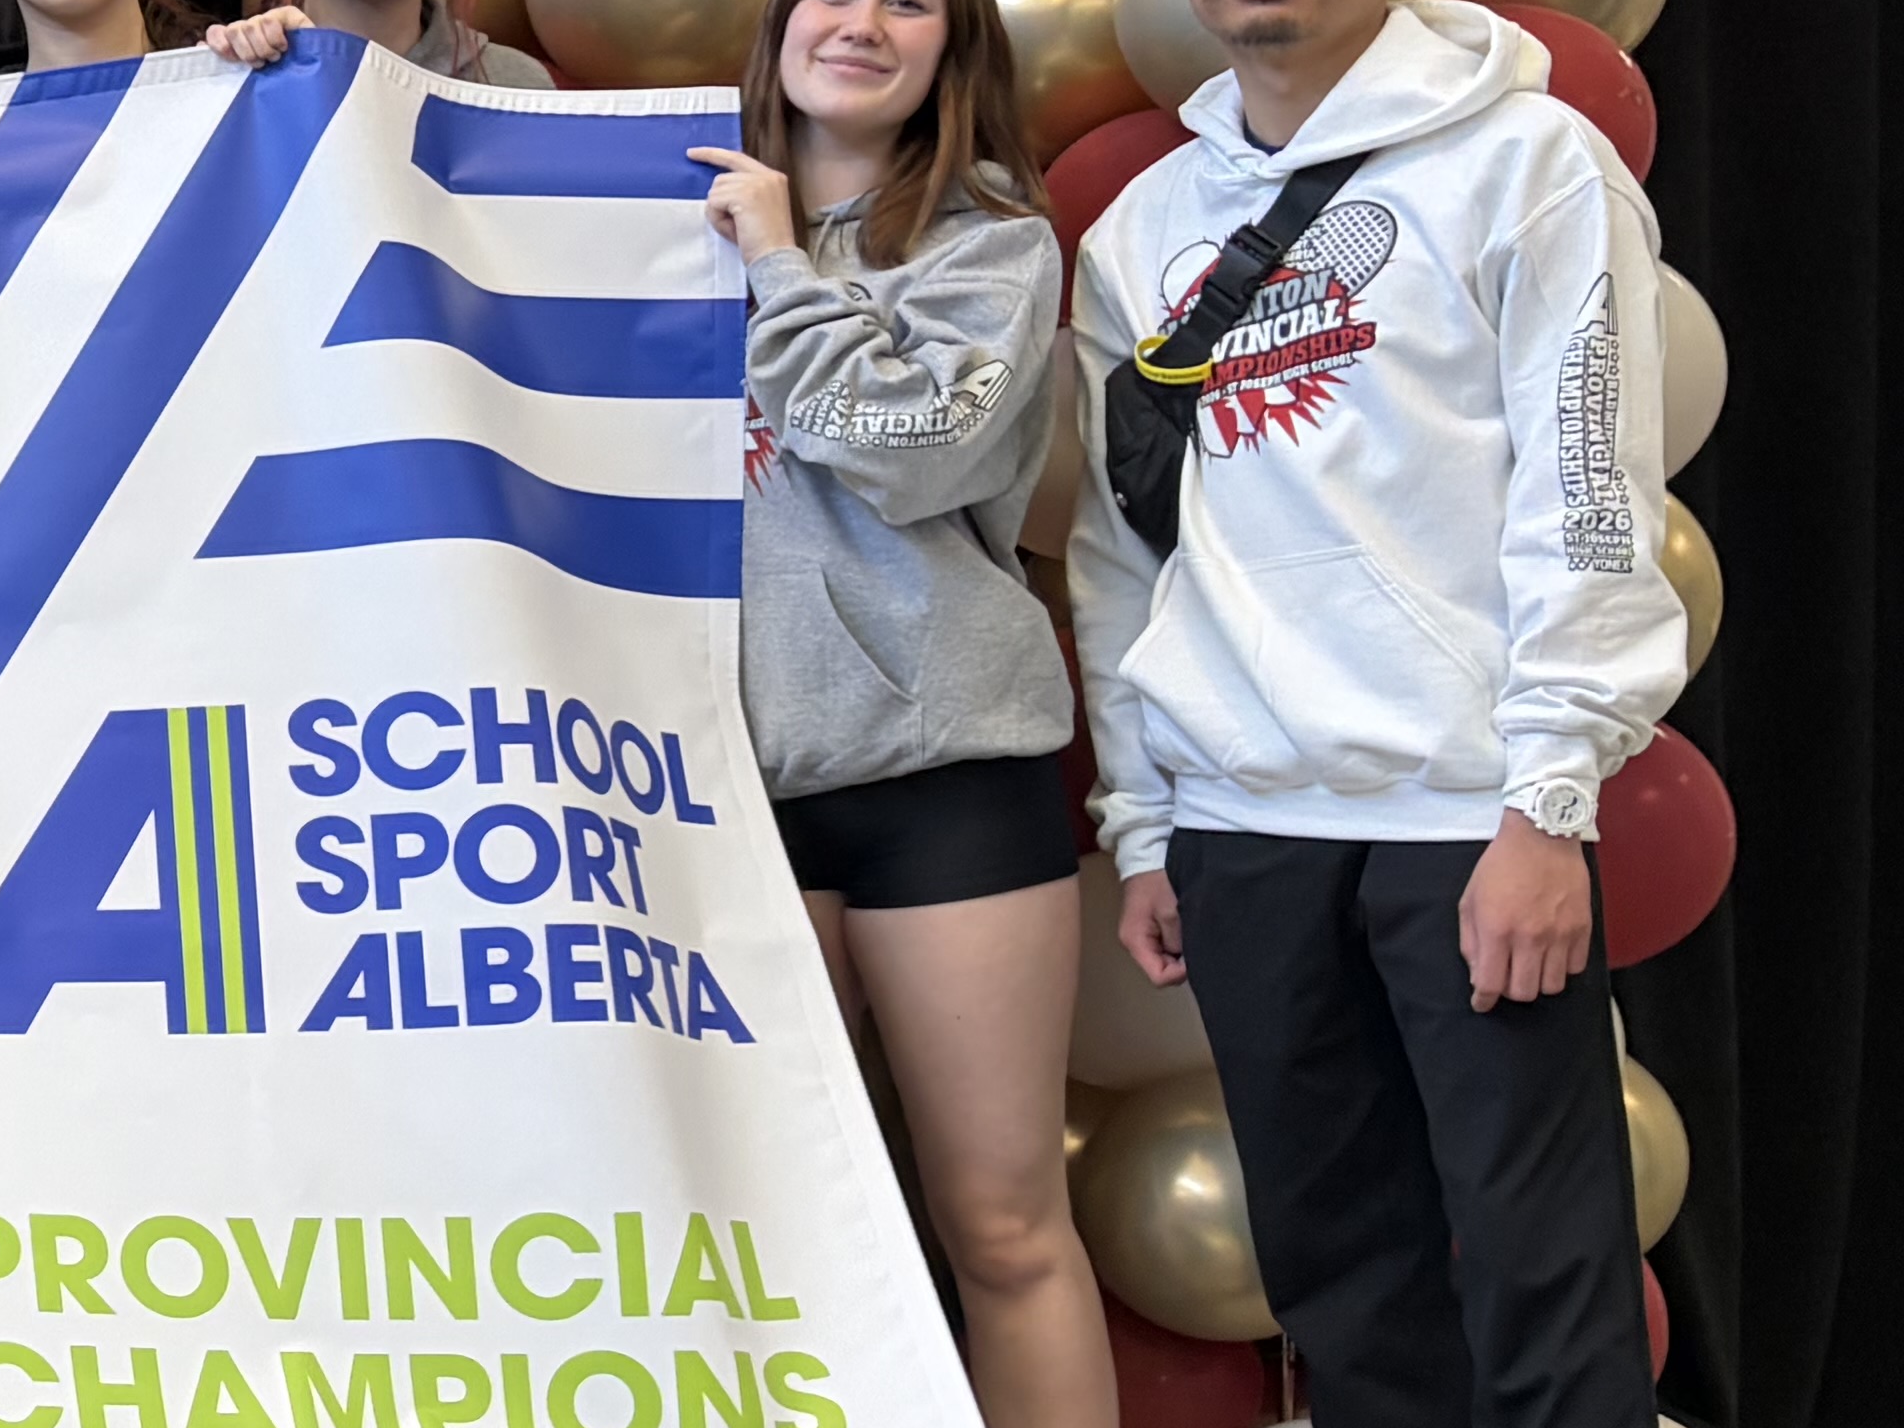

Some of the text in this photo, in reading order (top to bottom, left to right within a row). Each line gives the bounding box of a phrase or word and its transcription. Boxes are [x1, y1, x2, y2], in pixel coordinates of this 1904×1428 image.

[1565, 510, 1632, 531] 2026
[287, 686, 717, 827] SCHOOL
[293, 803, 651, 916] SPORT
[297, 923, 757, 1045] ALBERTA
